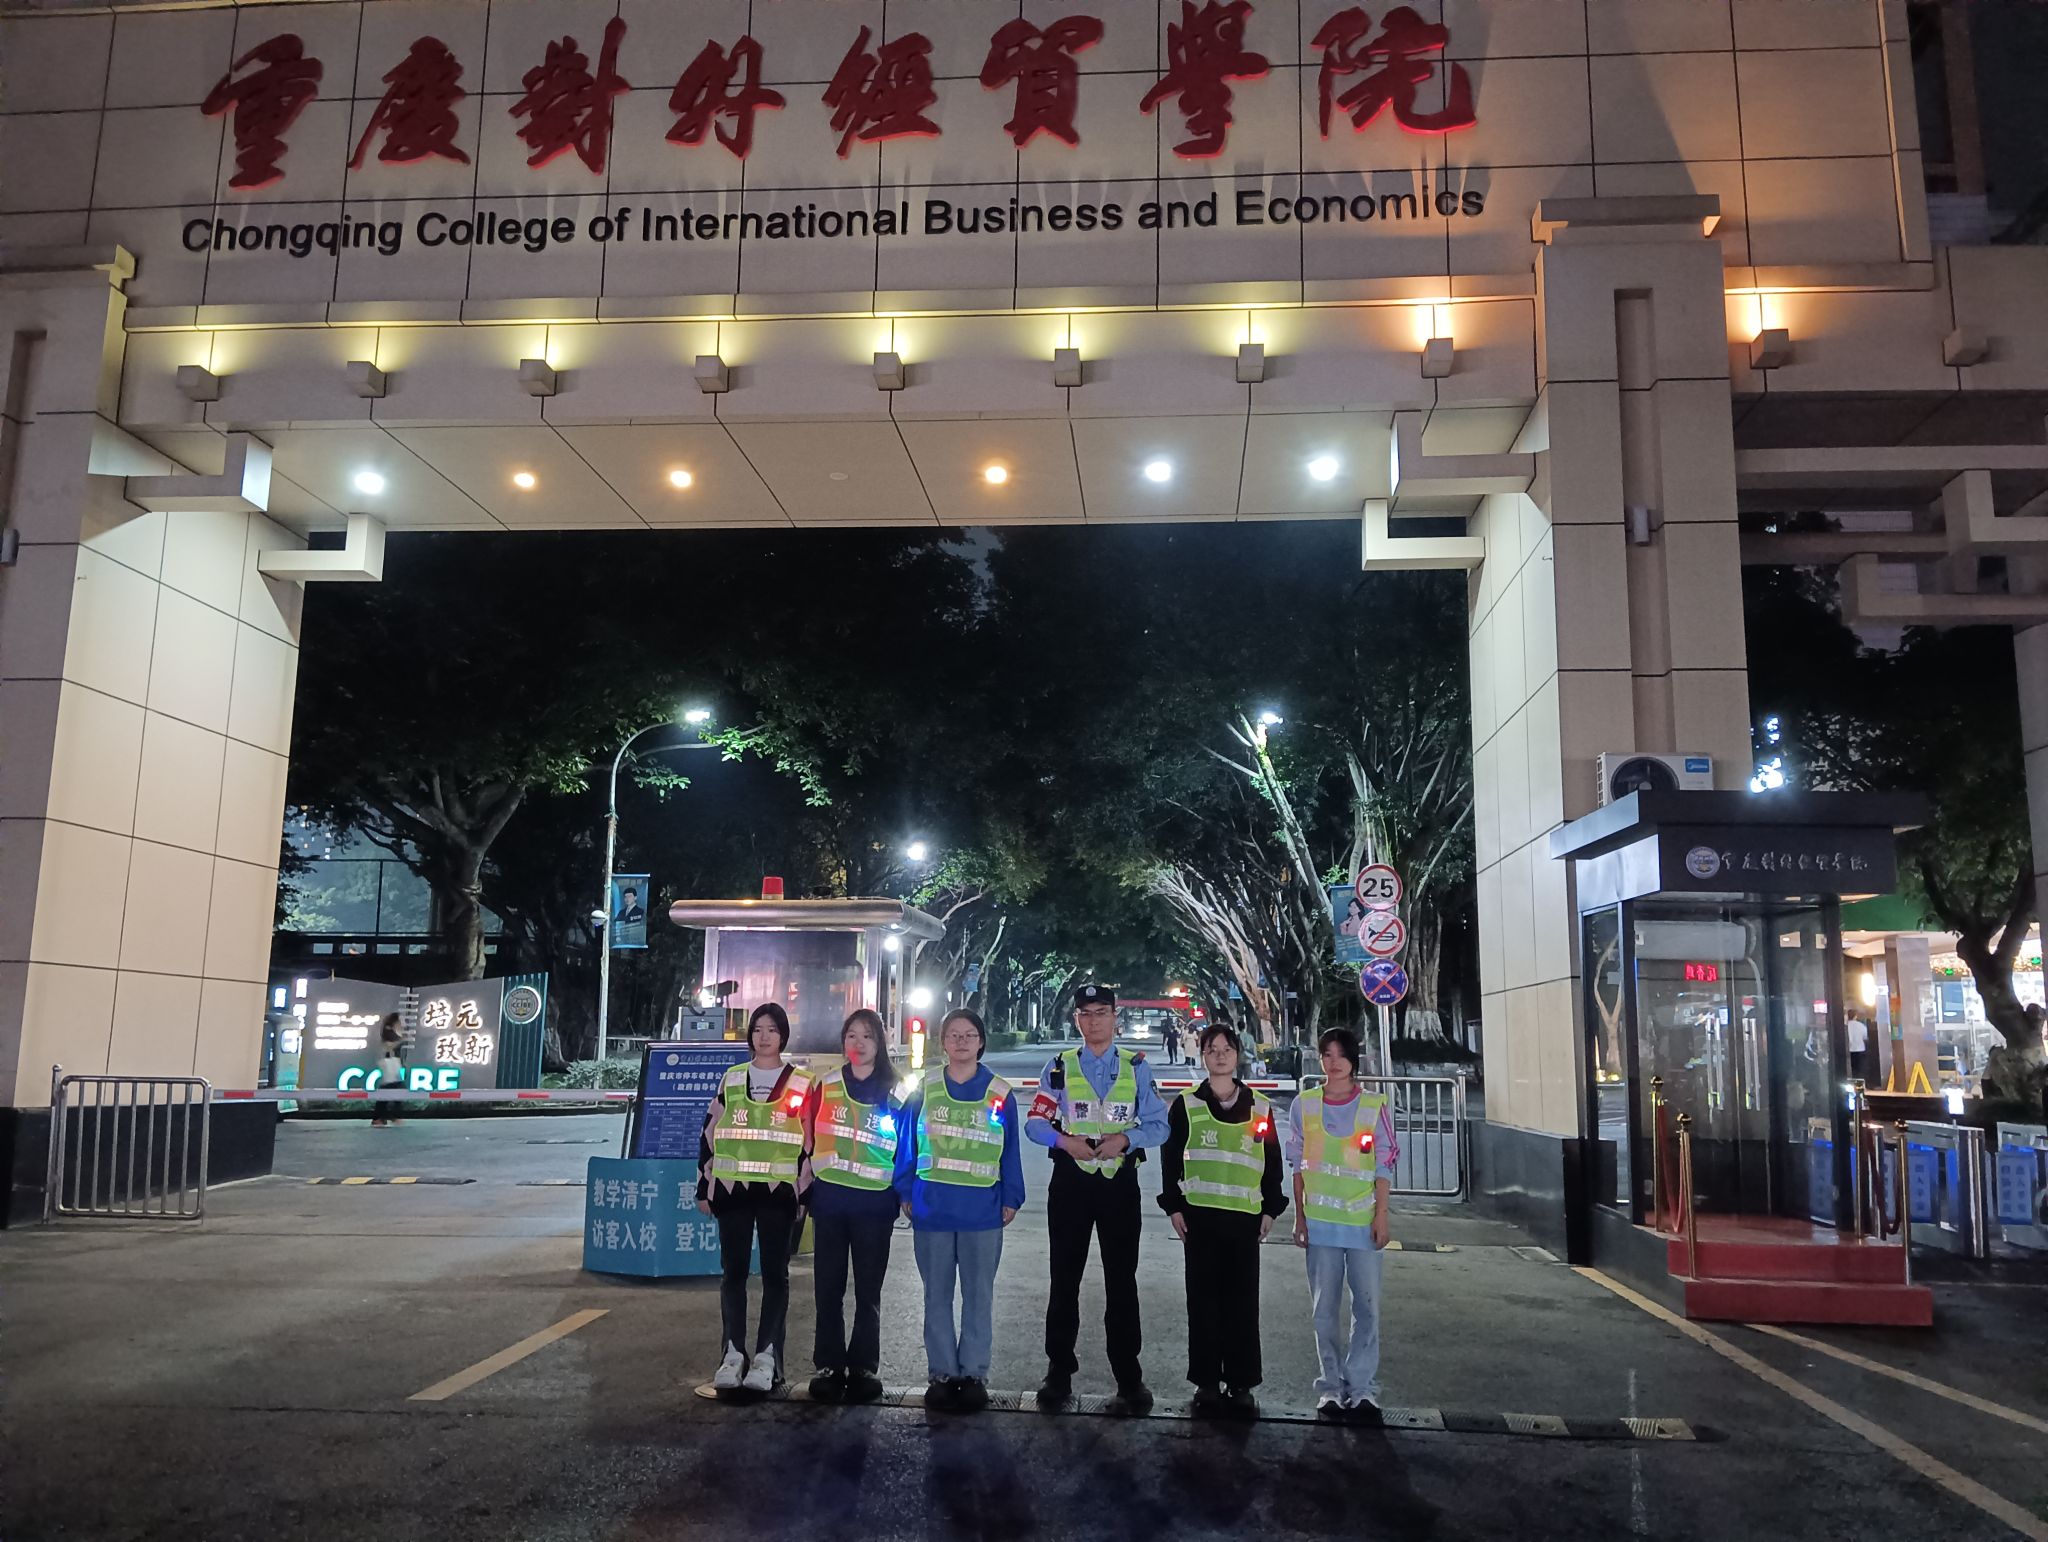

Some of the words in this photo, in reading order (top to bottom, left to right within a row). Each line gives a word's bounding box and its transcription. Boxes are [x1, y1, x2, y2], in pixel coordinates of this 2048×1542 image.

[181, 213, 403, 257] Chongqing
[416, 209, 576, 250] College
[588, 206, 632, 242] of
[642, 199, 908, 242] International
[924, 197, 1123, 236] Business
[1137, 191, 1218, 230] and
[1235, 184, 1485, 226] Economics
[1362, 877, 1394, 898] 25
[424, 1001, 481, 1028] 培元
[436, 1035, 491, 1062] 致新
[338, 1067, 459, 1091] CBE
[592, 1219, 657, 1251] 访客入校
[675, 1222, 721, 1252] 登记
